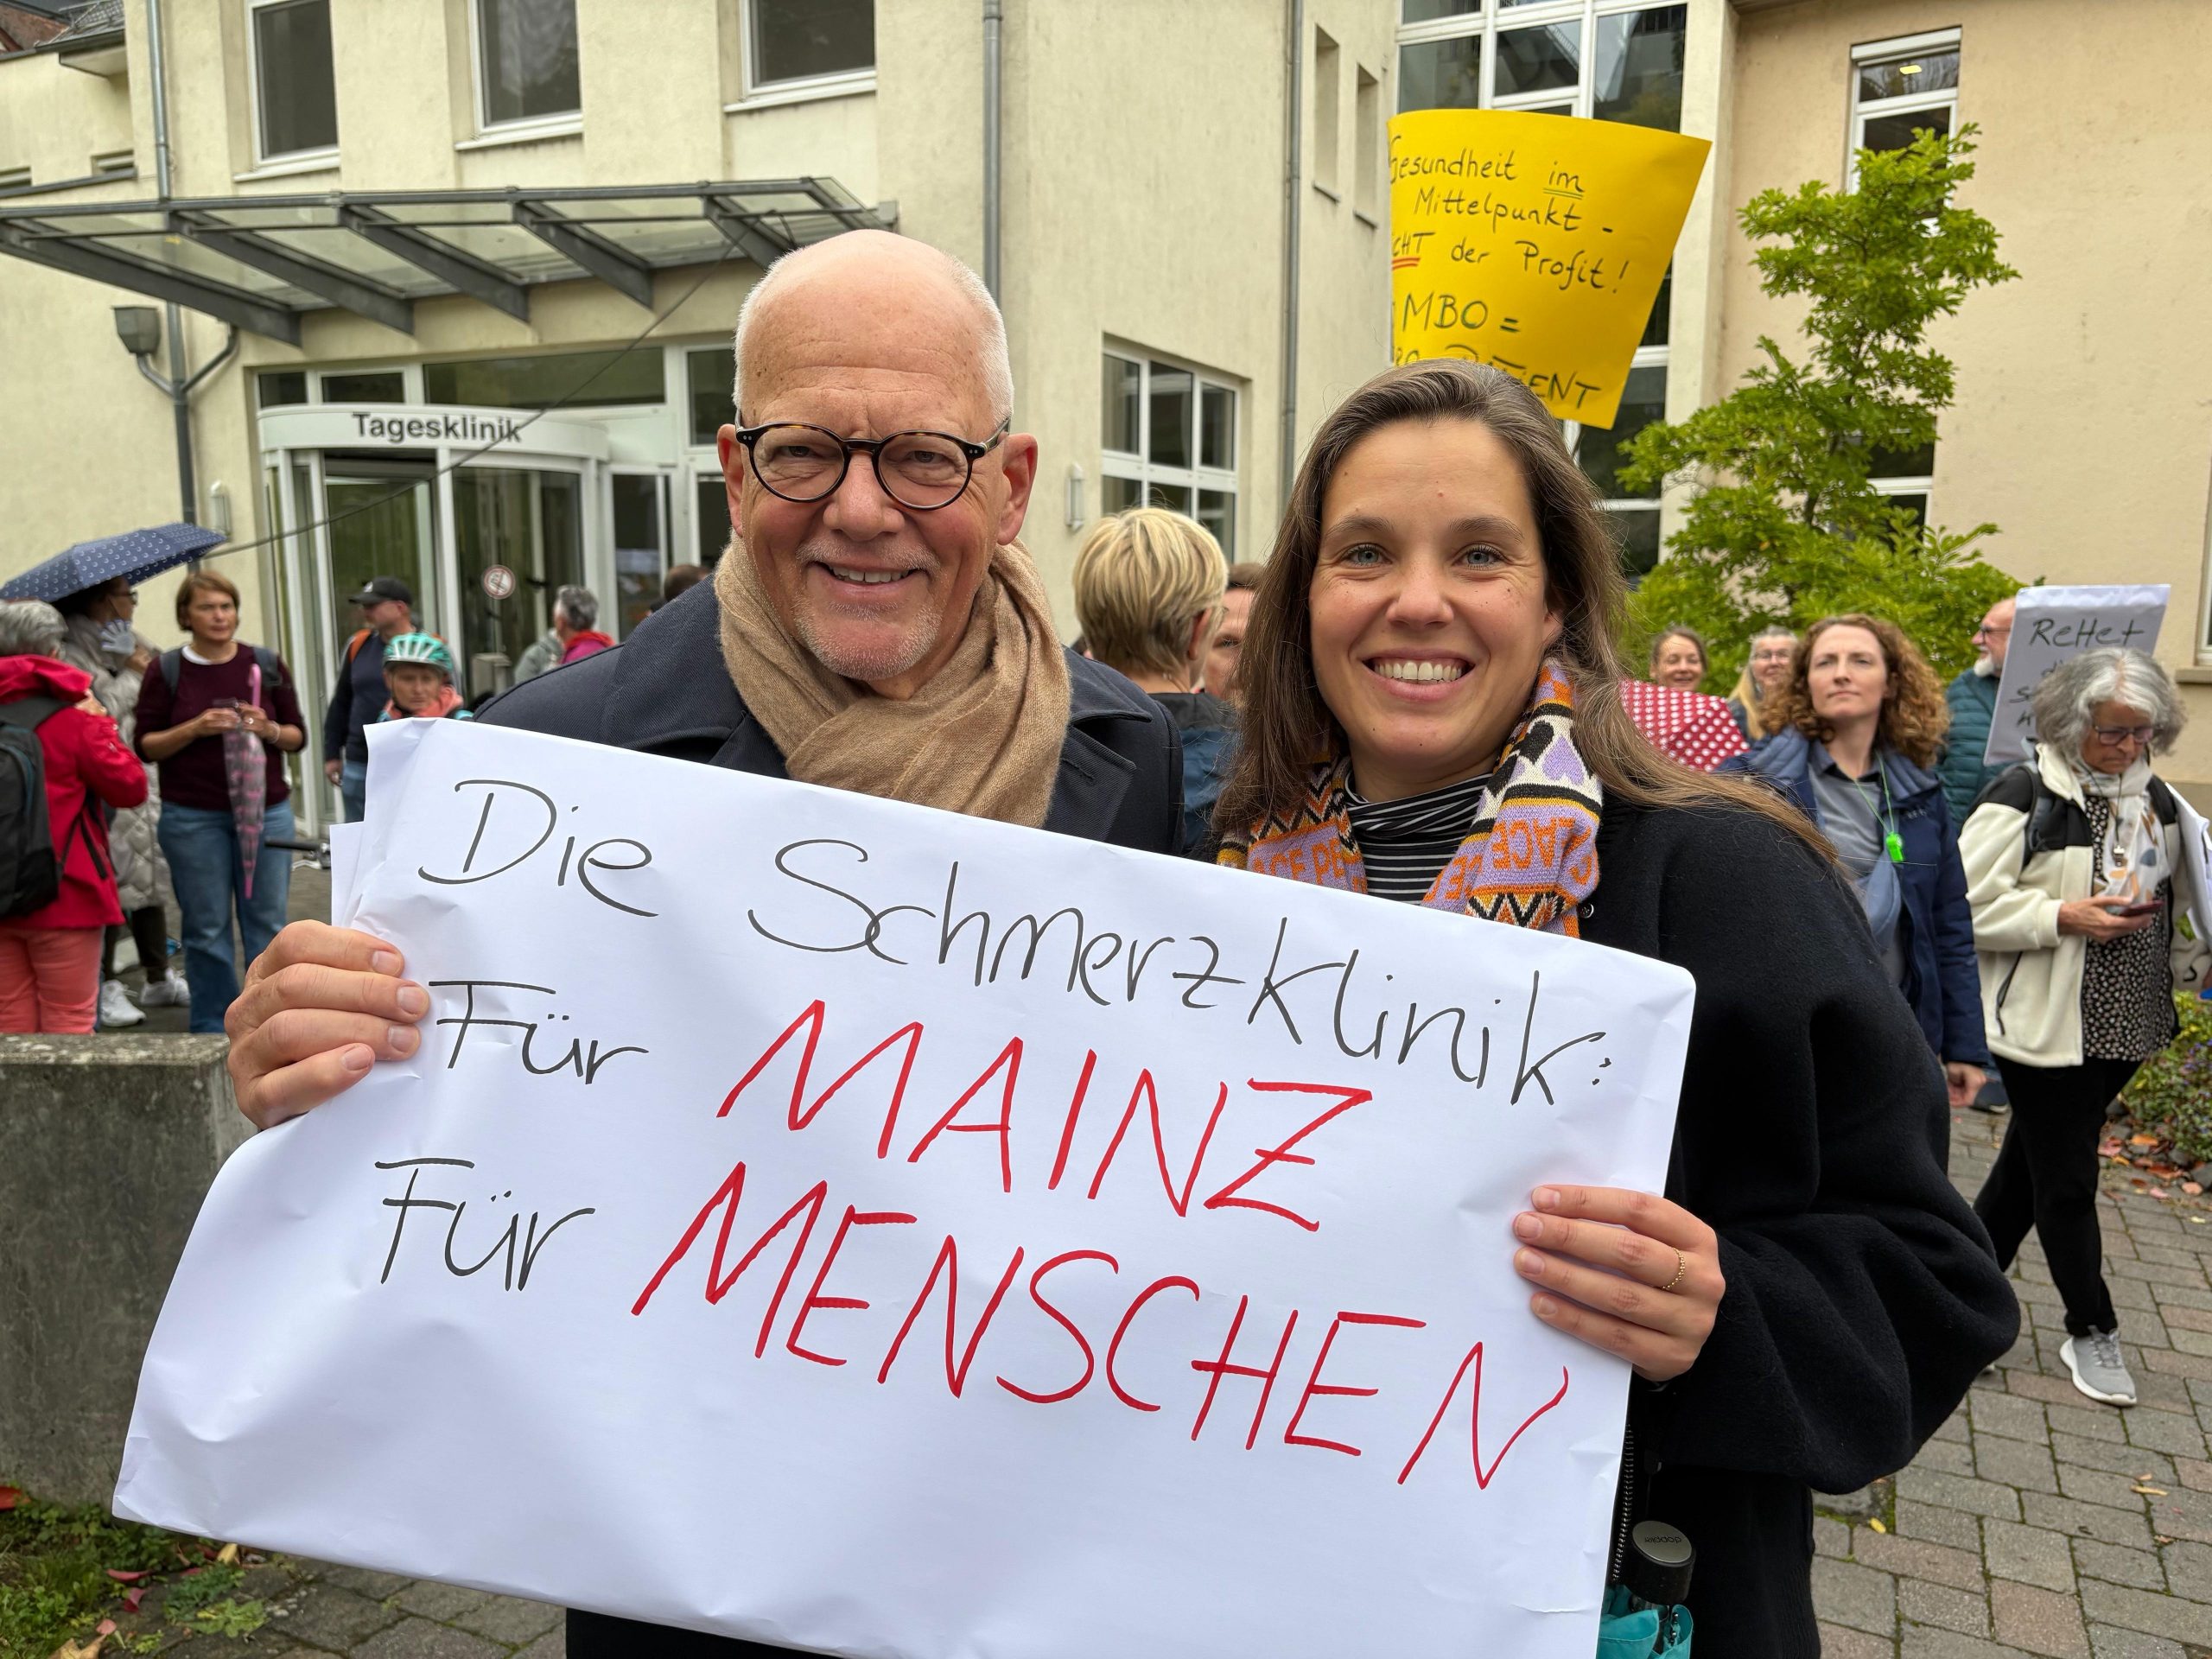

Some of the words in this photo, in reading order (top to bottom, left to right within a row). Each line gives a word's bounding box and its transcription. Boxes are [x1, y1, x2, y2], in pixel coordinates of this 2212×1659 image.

[1548, 162, 1586, 194] im
[1414, 187, 1583, 233] Mittelpunkt
[1391, 230, 1436, 257] CHT
[1450, 235, 1491, 264] der
[1514, 240, 1630, 294] Profit!
[1402, 292, 1489, 332] MBO
[352, 411, 522, 443] Tagesklinik
[417, 779, 659, 918] Die
[428, 980, 650, 1086] Für
[716, 998, 1374, 1233] MAINZ
[373, 1156, 597, 1293] Für
[631, 1160, 1569, 1491] MENSCHEN
